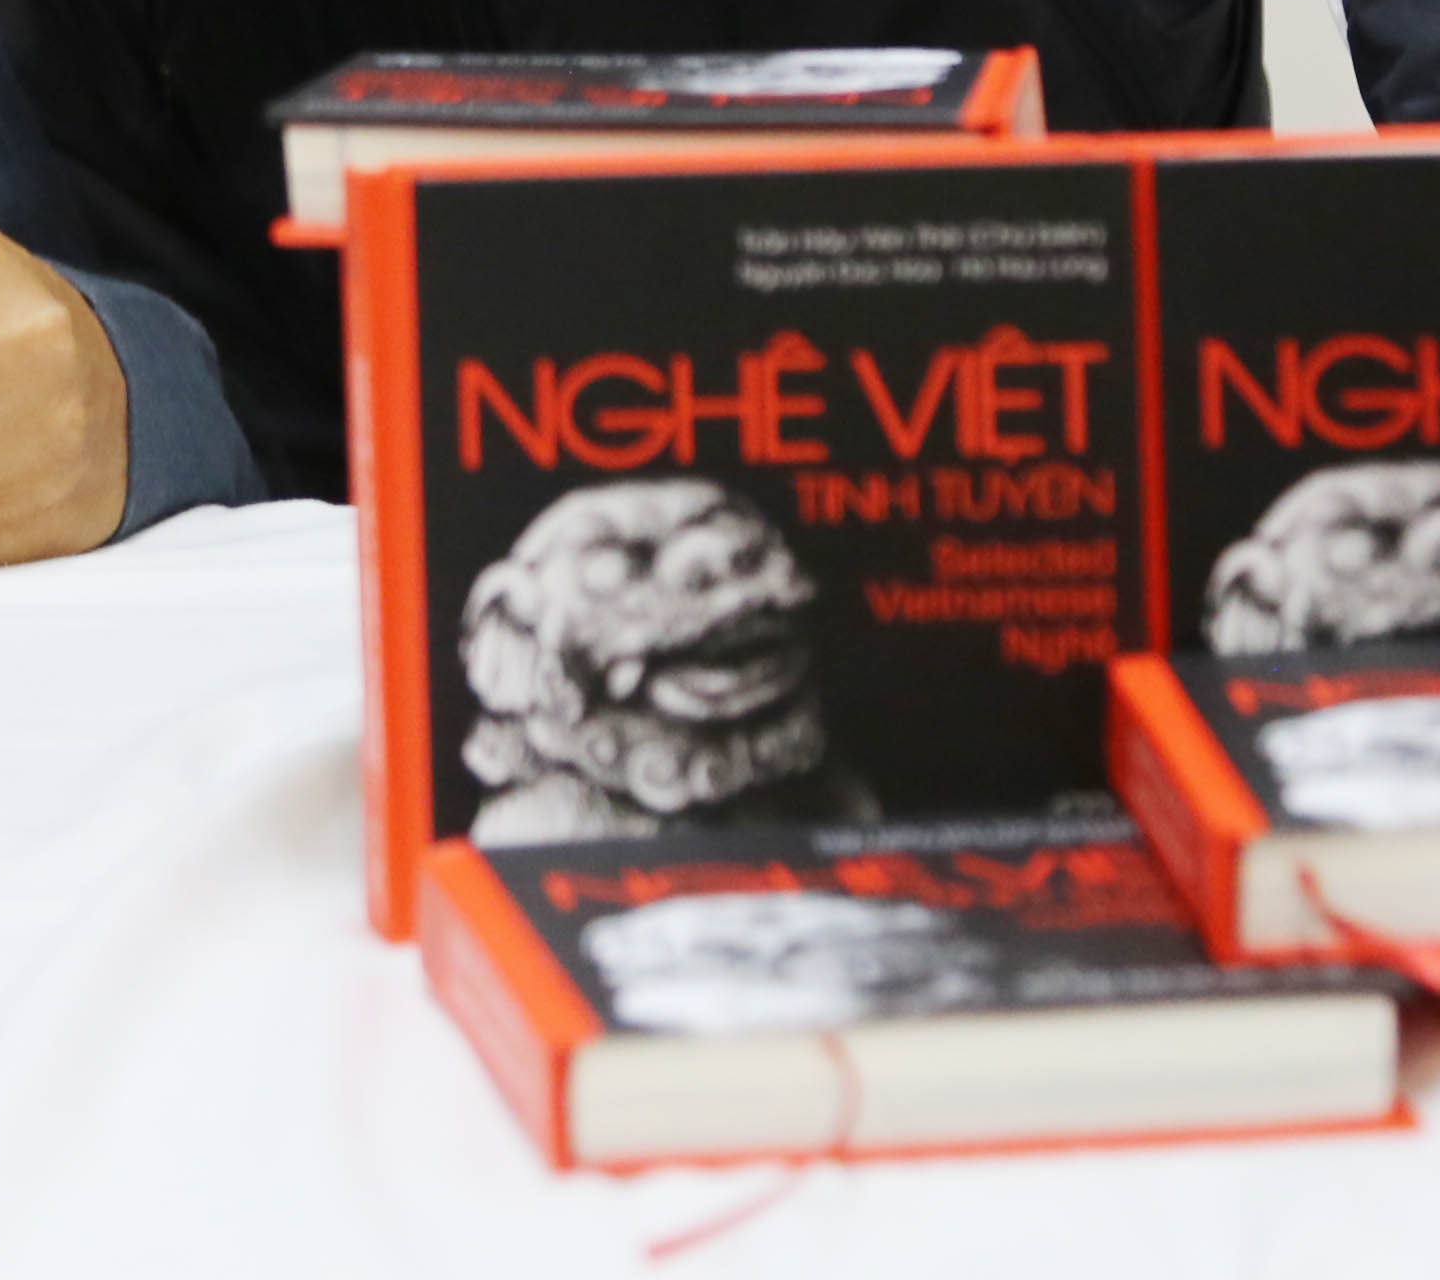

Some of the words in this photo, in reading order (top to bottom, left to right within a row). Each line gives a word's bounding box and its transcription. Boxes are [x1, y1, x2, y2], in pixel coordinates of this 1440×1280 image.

[456, 329, 829, 471] NGHÊ
[849, 323, 1110, 466] VIỆT
[794, 470, 920, 526] TINH
[931, 536, 1118, 578] Selected
[865, 582, 1118, 623] Vietnamese
